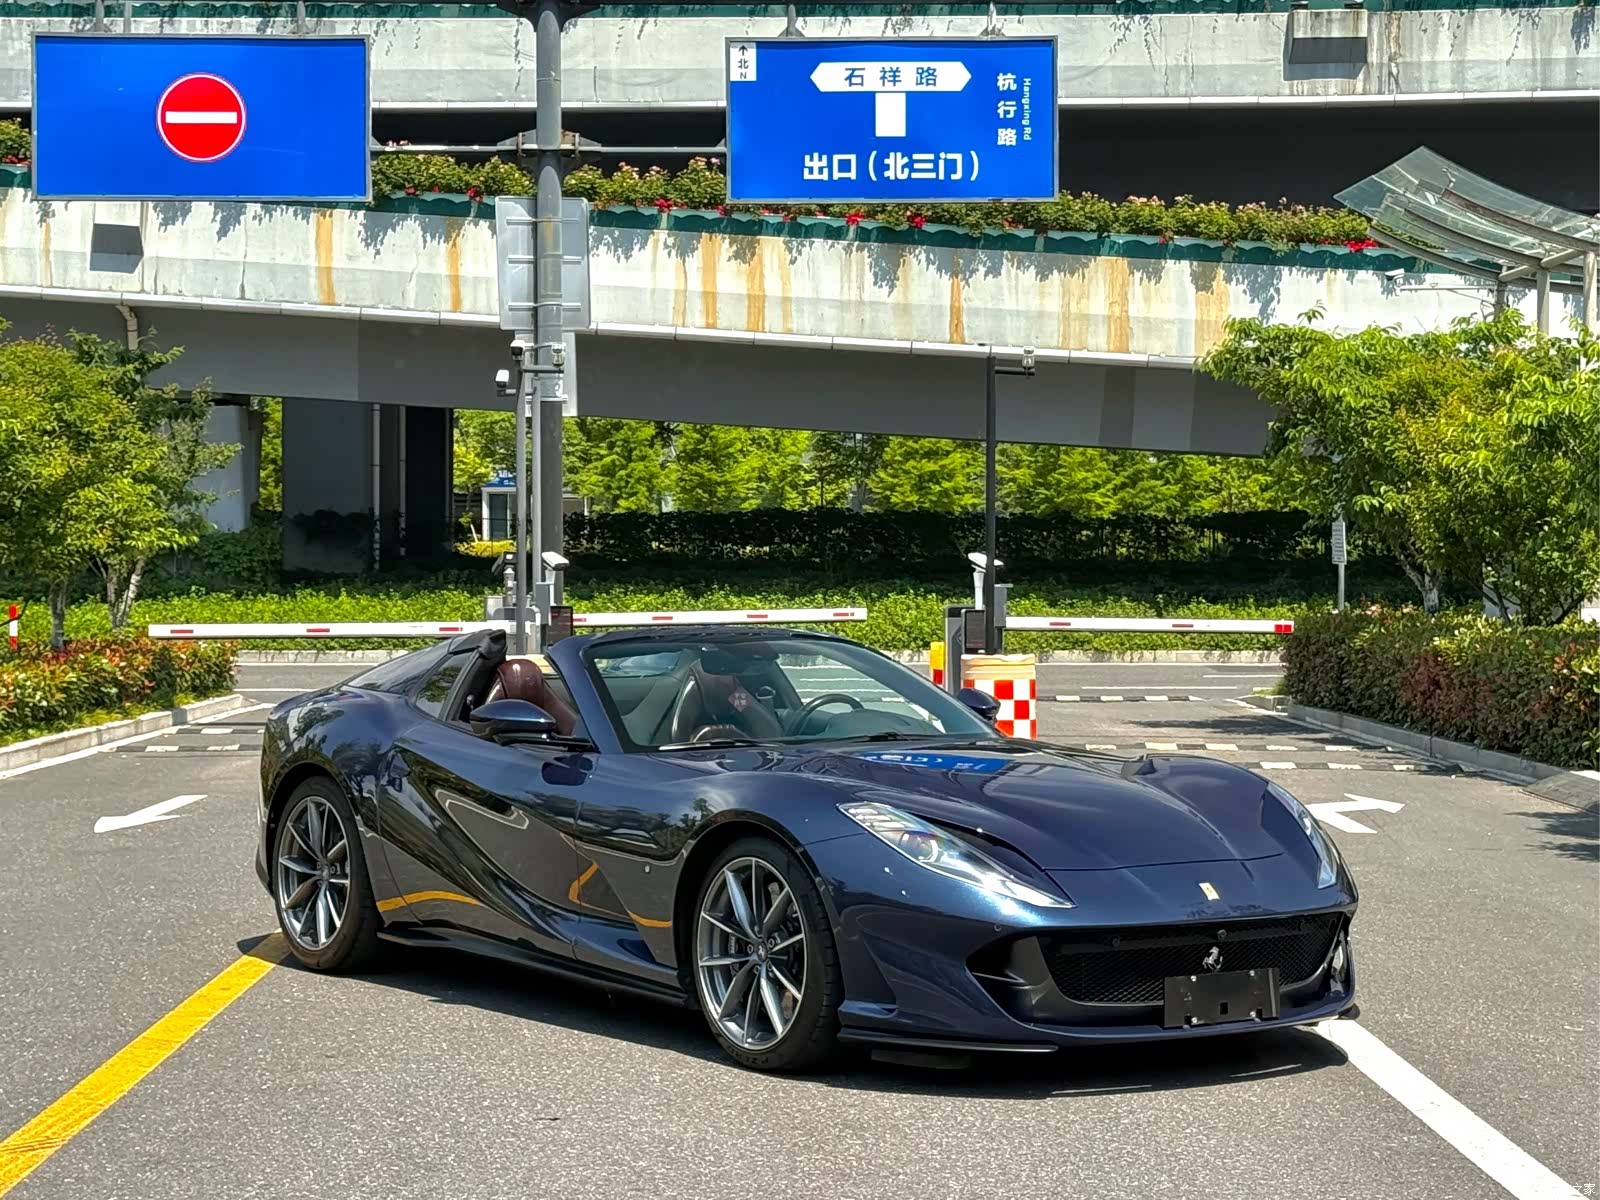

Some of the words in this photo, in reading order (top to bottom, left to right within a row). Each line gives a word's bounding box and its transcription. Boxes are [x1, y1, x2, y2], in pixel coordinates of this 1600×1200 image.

[738, 58, 749, 69] 北
[740, 71, 747, 79] N
[844, 66, 938, 87] 石祥路
[997, 72, 1017, 146] 杭行路
[1021, 78, 1032, 125] Hangxing
[1023, 127, 1032, 140] Rd
[803, 150, 979, 181] 出口（北三门）
